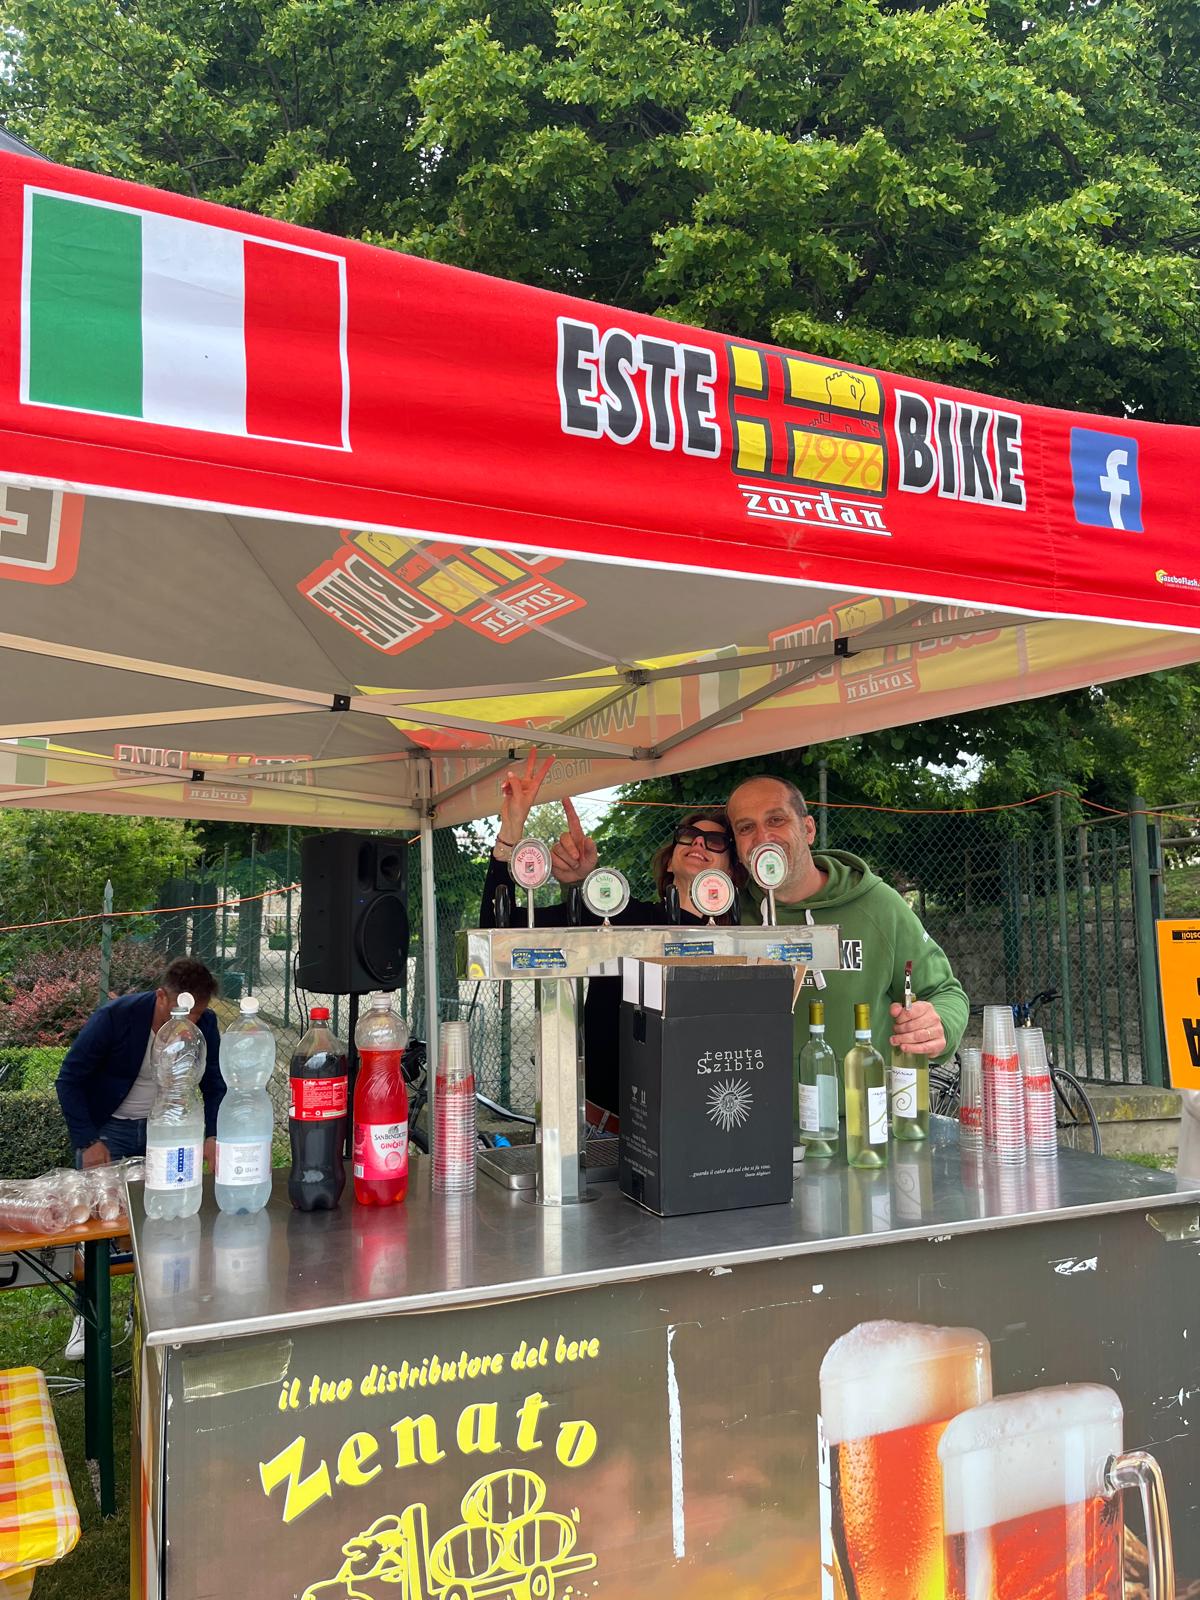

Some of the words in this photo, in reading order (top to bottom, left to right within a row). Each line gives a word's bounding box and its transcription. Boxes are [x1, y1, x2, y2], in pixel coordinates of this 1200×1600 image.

[557, 316, 721, 459] ESTE
[894, 388, 1027, 512] BIKE
[795, 432, 883, 490] 1996
[742, 491, 887, 529] zordan
[703, 1048, 763, 1061] tenuta
[277, 1378, 301, 1412] il
[309, 1376, 352, 1405] tuo
[360, 1352, 504, 1396] distributore
[511, 1339, 548, 1369] del
[554, 1334, 600, 1363] bere
[258, 1391, 599, 1524] Zenato
